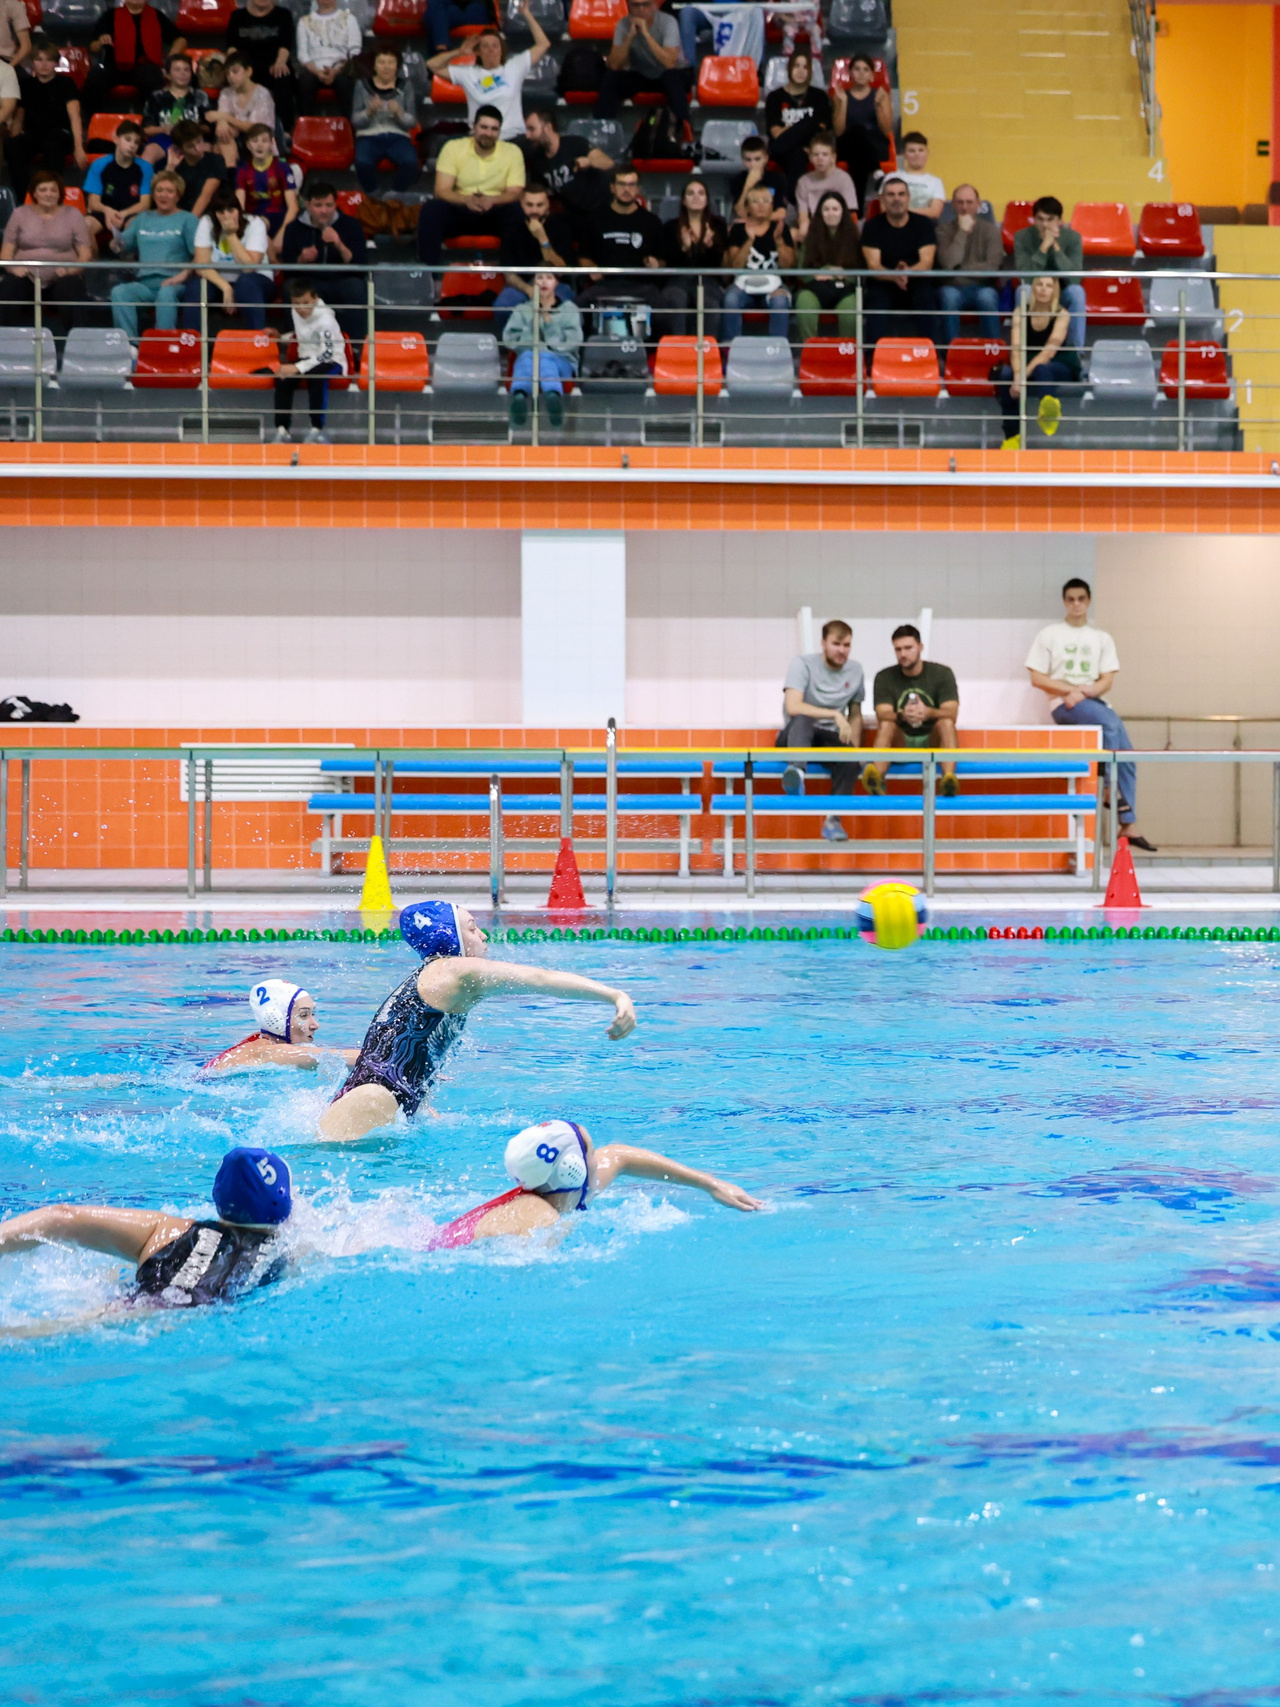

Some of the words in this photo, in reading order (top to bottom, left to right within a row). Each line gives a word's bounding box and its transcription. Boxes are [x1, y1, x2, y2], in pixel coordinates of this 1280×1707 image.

[903, 90, 919, 115] 5
[1148, 160, 1165, 183] 4
[1229, 308, 1244, 333] 2
[1244, 379, 1252, 404] 1
[413, 910, 433, 931] 4
[255, 986, 271, 1006] 2
[535, 1142, 560, 1165] 8
[256, 1157, 277, 1186] 5
